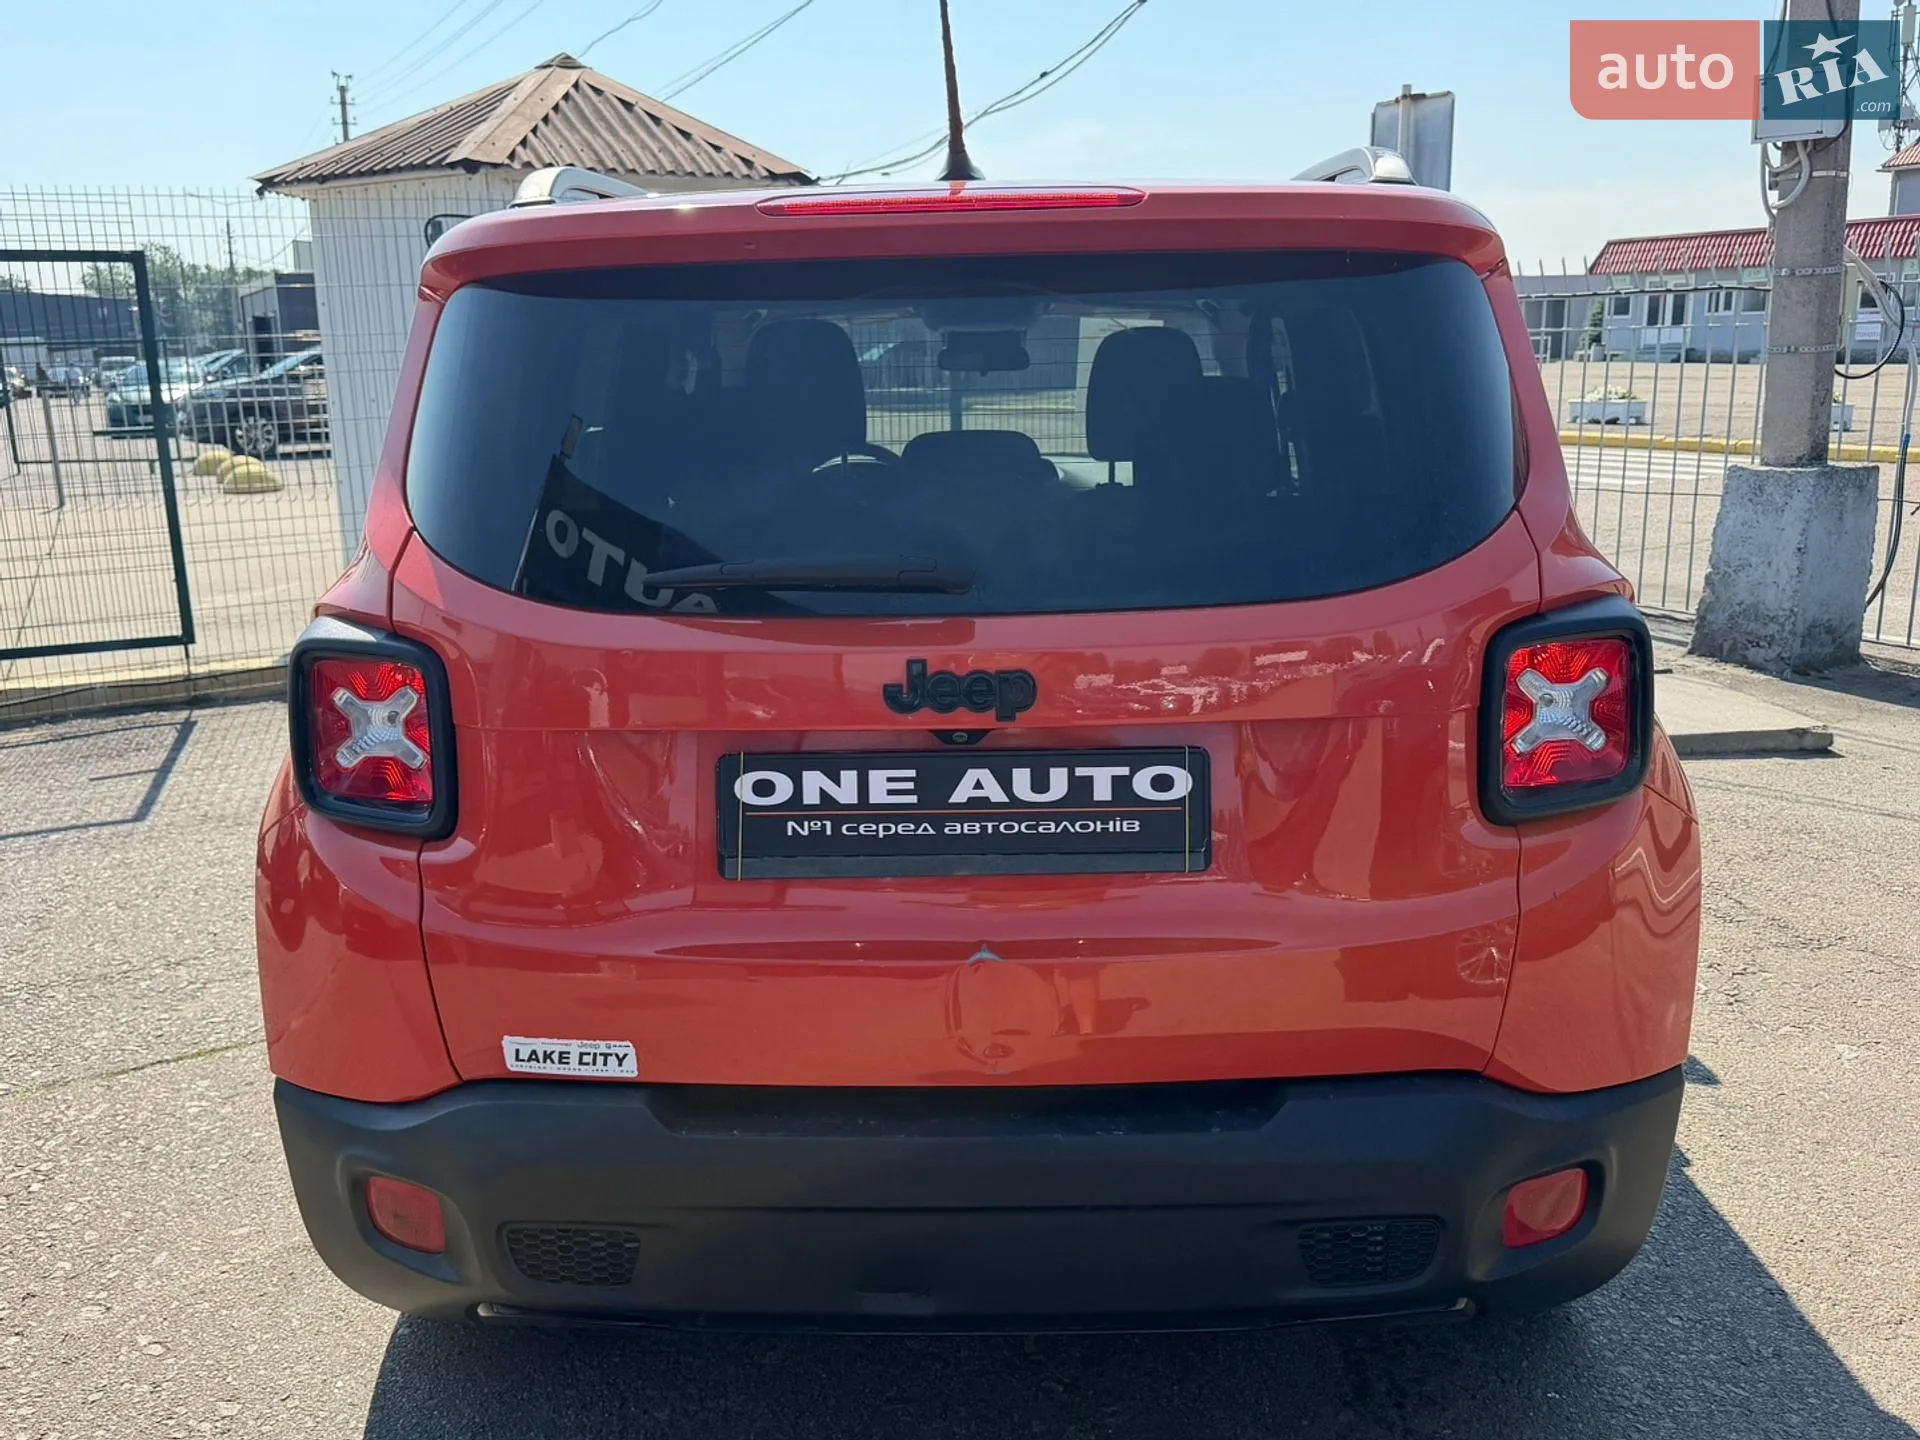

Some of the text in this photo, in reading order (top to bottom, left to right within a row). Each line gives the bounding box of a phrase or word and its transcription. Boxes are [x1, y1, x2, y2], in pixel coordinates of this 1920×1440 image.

[882, 658, 1038, 722] Jeep
[733, 765, 1193, 806] ONE AUTO
[841, 821, 936, 838] серед
[943, 817, 1141, 835] автосалонів
[514, 1048, 629, 1068] LAKE CITY
